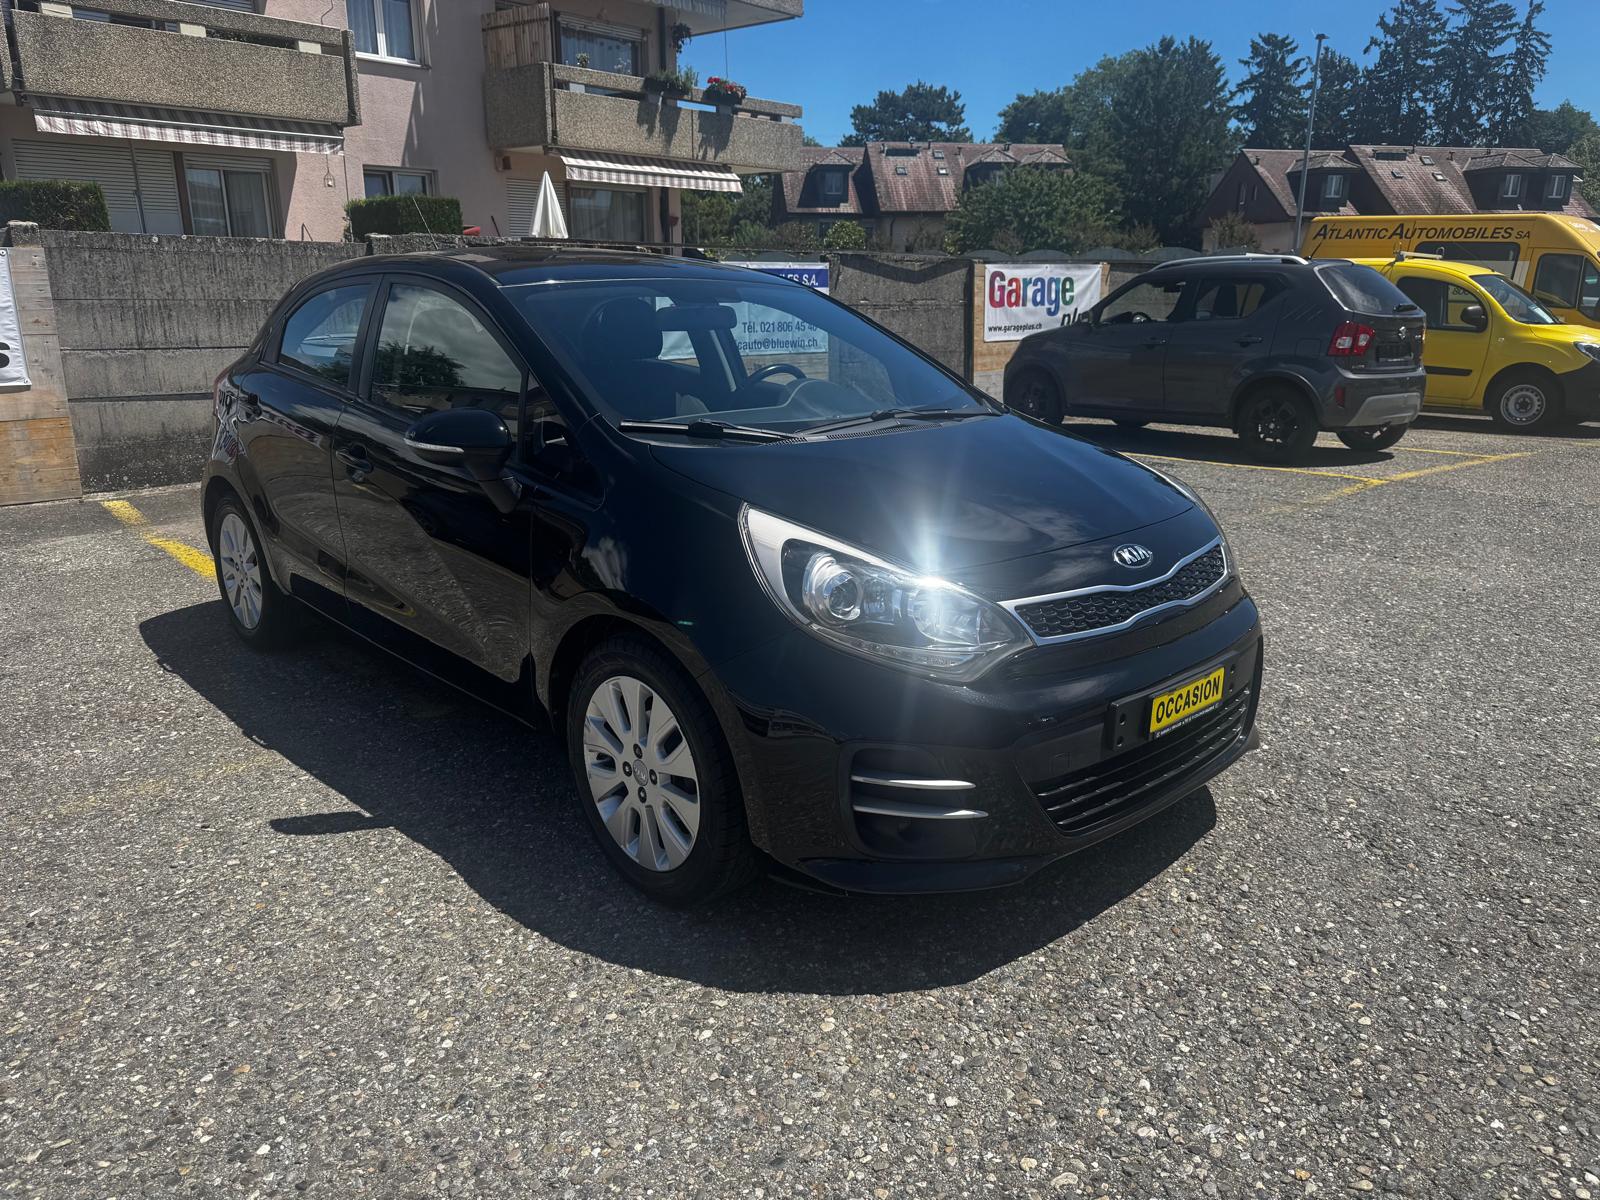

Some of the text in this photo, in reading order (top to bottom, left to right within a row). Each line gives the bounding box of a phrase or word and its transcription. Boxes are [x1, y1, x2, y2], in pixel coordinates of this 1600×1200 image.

[1312, 222, 1531, 240] ATLANTIC AUTOMOBILES SA
[802, 273, 819, 286] S.A.
[989, 270, 1075, 317] Garage
[742, 320, 758, 334] Tél.
[760, 320, 776, 333] 021
[777, 320, 793, 333] 806
[795, 320, 806, 332] 45
[988, 322, 1043, 333] www.garageplus.ch
[1118, 545, 1150, 565] KIA
[1156, 675, 1220, 724] OCCASION
